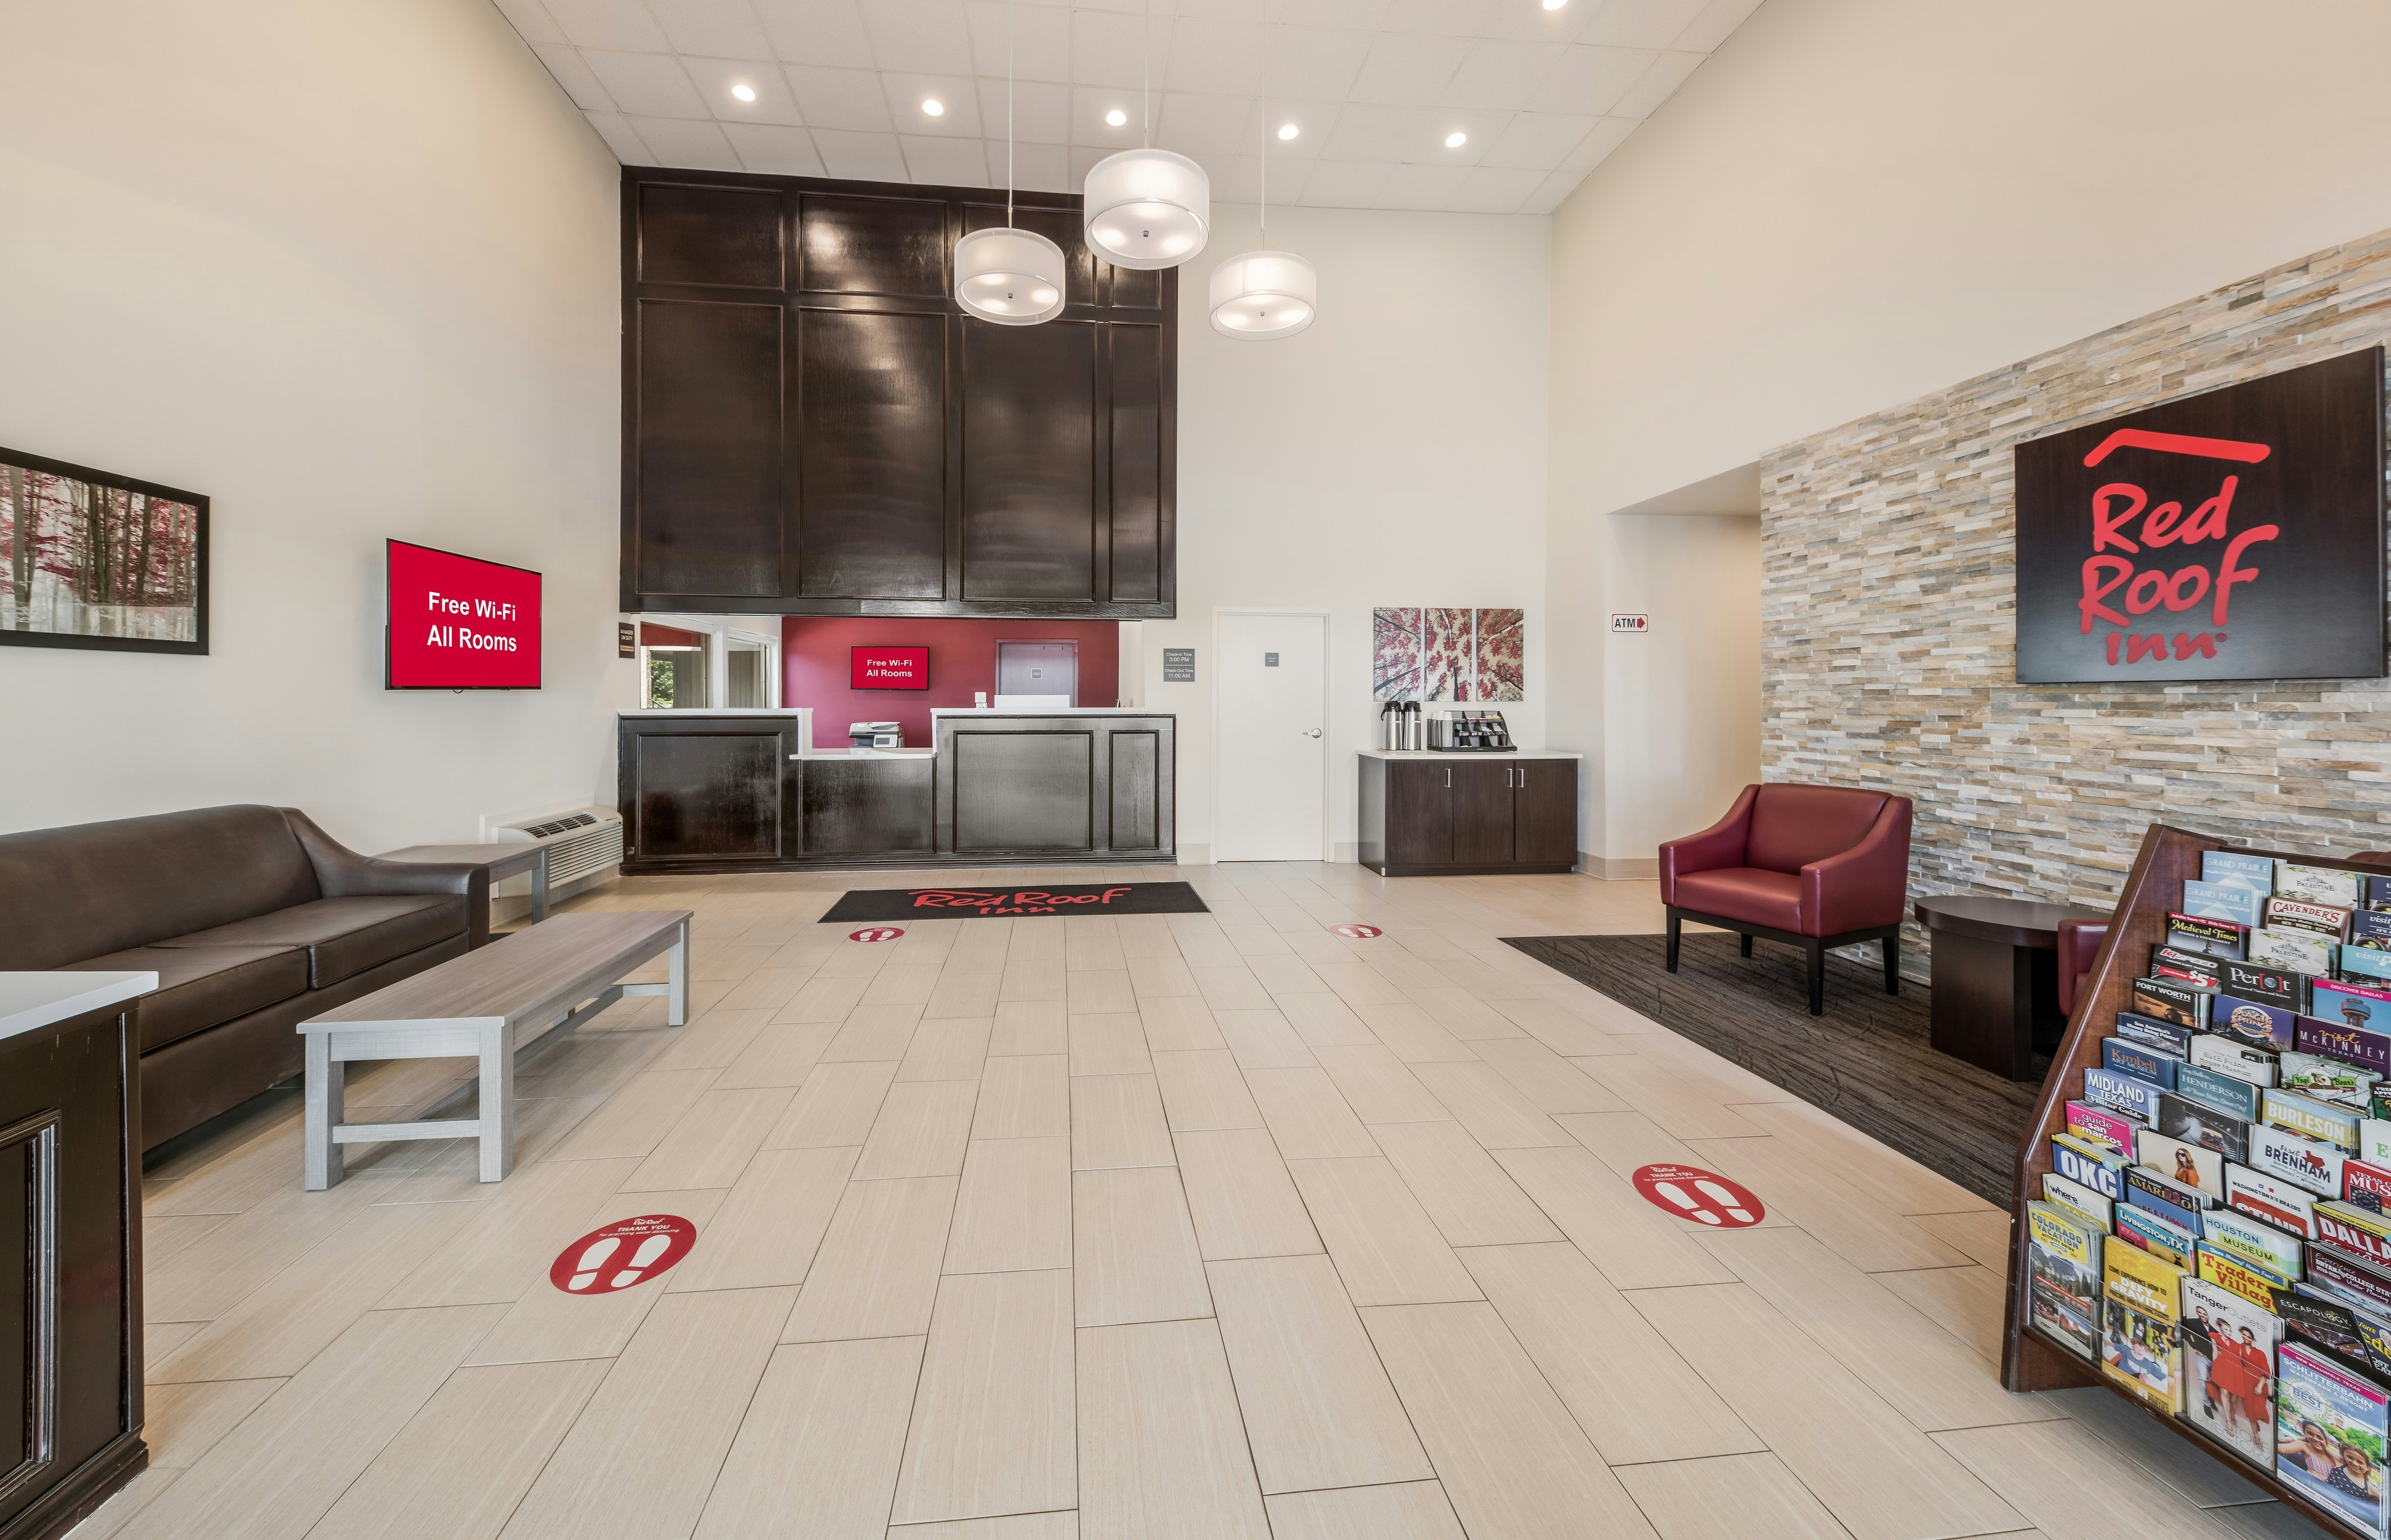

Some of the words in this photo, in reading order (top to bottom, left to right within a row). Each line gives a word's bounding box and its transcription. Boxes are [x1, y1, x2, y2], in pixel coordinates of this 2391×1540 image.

[2093, 475, 2238, 553] Red
[2078, 524, 2279, 634] Roof
[429, 591, 470, 615] Free
[475, 599, 516, 621] Wi-Fi
[1614, 618, 1636, 628] ATM
[427, 624, 452, 647] All
[460, 628, 517, 652] Rooms
[2205, 858, 2235, 868] GRAND
[2239, 862, 2267, 873] PRAIRIE
[2186, 888, 2215, 898] GRAND
[2219, 893, 2249, 904] PRAIRIE
[2296, 880, 2335, 891] PALESTINE
[914, 894, 1009, 907] Red
[1014, 888, 1132, 905] Roof
[2274, 902, 2340, 923] CAVENDER'S
[2171, 919, 2211, 935] Medieval
[2212, 929, 2238, 941] Times
[2199, 935, 2230, 944] TOURNAMENT
[2271, 947, 2307, 960] PALESTINE
[2356, 952, 2381, 961] visit
[2136, 982, 2157, 992] FORT
[2158, 987, 2190, 1001] WORTH
[2330, 985, 2359, 993] DISCOVER
[2231, 1014, 2272, 1033] SPRINGS
[2232, 1008, 2272, 1025] MAGIC
[2127, 1023, 2143, 1032] Money
[2159, 1033, 2179, 1042] Printed
[2319, 1030, 2361, 1043] visit
[2111, 1048, 2156, 1071] Kimbell
[2203, 1052, 2222, 1062] Ruth
[2224, 1058, 2247, 1069] Paine
[2328, 1048, 2354, 1057] TEXAS
[2127, 1062, 2157, 1076] MUSEUM
[2199, 1057, 2221, 1067] House
[2222, 1064, 2251, 1076] Museum
[2088, 1073, 2144, 1103] MIDLAND
[2100, 1090, 2133, 1107] TEXAS
[2182, 1075, 2247, 1103] HENDERSON
[2091, 1096, 2117, 1110] Visitor
[2118, 1106, 2143, 1120] Guide
[2074, 1116, 2085, 1125] to
[2088, 1123, 2107, 1134] san
[2082, 1114, 2113, 1130] guide
[2268, 1102, 2345, 1141] BURLESON
[2082, 1126, 2123, 1147] marcos
[2265, 1144, 2330, 1183] BRENHAM
[2061, 1151, 2117, 1198] OKC
[2130, 1173, 2146, 1182] VISITOR
[2148, 1180, 2162, 1189] GUIDE
[2356, 1171, 2383, 1184] TEXAS
[2050, 1185, 2078, 1204] where
[2232, 1180, 2269, 1198] WASHINGTON
[2279, 1200, 2301, 1212] BRAZOS
[2032, 1212, 2082, 1244] COLORADO
[2335, 1214, 2354, 1223] TRAVELER
[2036, 1223, 2079, 1250] VACATION
[2206, 1218, 2259, 1244] HOUSTON
[2354, 1226, 2371, 1235] HELPFUL
[2042, 1233, 2060, 1244] ACTIVITY
[2062, 1242, 2075, 1252] GUIDE
[2223, 1236, 2273, 1261] MUSEUM
[2209, 1247, 2224, 1256] Save
[2225, 1254, 2244, 1266] Money!
[2246, 1263, 2260, 1274] Have
[2261, 1270, 2275, 1280] Fun!
[2316, 1253, 2356, 1275] Experience
[2316, 1265, 2340, 1280] 2019-2020
[2109, 1265, 2120, 1275] COME
[2121, 1271, 2147, 1287] EXPERIENCE
[2147, 1282, 2159, 1292] HOW
[2316, 1259, 2338, 1273] BRYAN
[2346, 1273, 2375, 1290] COLLEGE
[2111, 1281, 2167, 1312] GRAVITY
[2121, 1276, 2154, 1298] DEFY
[2215, 1269, 2276, 1309] Villag
[2347, 1279, 2365, 1290] Visitor
[2366, 1288, 2389, 1303] Planning
[2283, 1357, 2373, 1410] SCHLITTERBAHN
[2295, 1356, 2308, 1364] NEW
[2343, 1380, 2361, 1392] TEXAS
[2289, 1368, 2331, 1393] WATERPARK
[2340, 1394, 2368, 1412] RESORT
[2293, 1387, 2323, 1408] BEST
[2297, 1385, 2320, 1400] WORLD'S
[2194, 1411, 2271, 1463] DIRECTORY
[2226, 1420, 2270, 1455] STORE
[2284, 1474, 2295, 1483] FREE
[2296, 1482, 2316, 1496] PARKING
[2320, 1497, 2342, 1512] COOLERS
[2343, 1511, 2367, 1528] WELCOME
